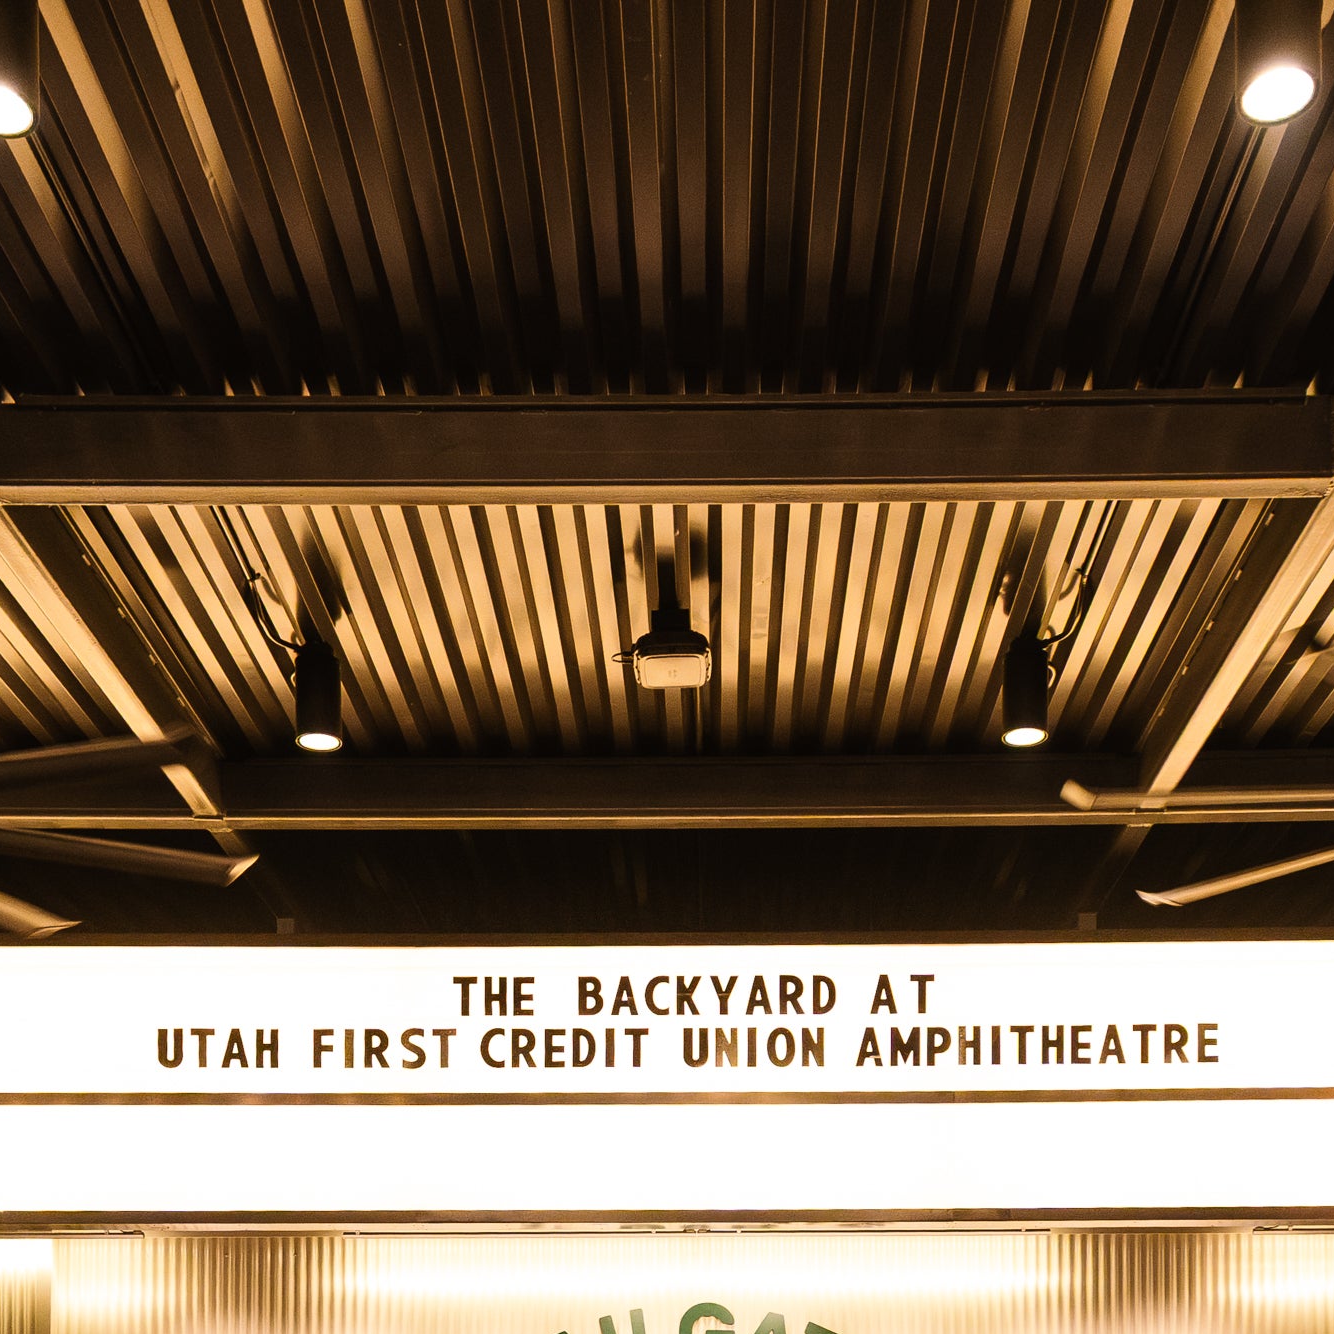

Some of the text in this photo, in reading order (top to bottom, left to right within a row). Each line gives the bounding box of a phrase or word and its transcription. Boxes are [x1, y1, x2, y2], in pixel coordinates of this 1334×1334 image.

[452, 974, 935, 1017] THE BACKYARD AT
[157, 1023, 1219, 1070] UTAH FIRST CREDIT UNION AMPHITHEATRE
